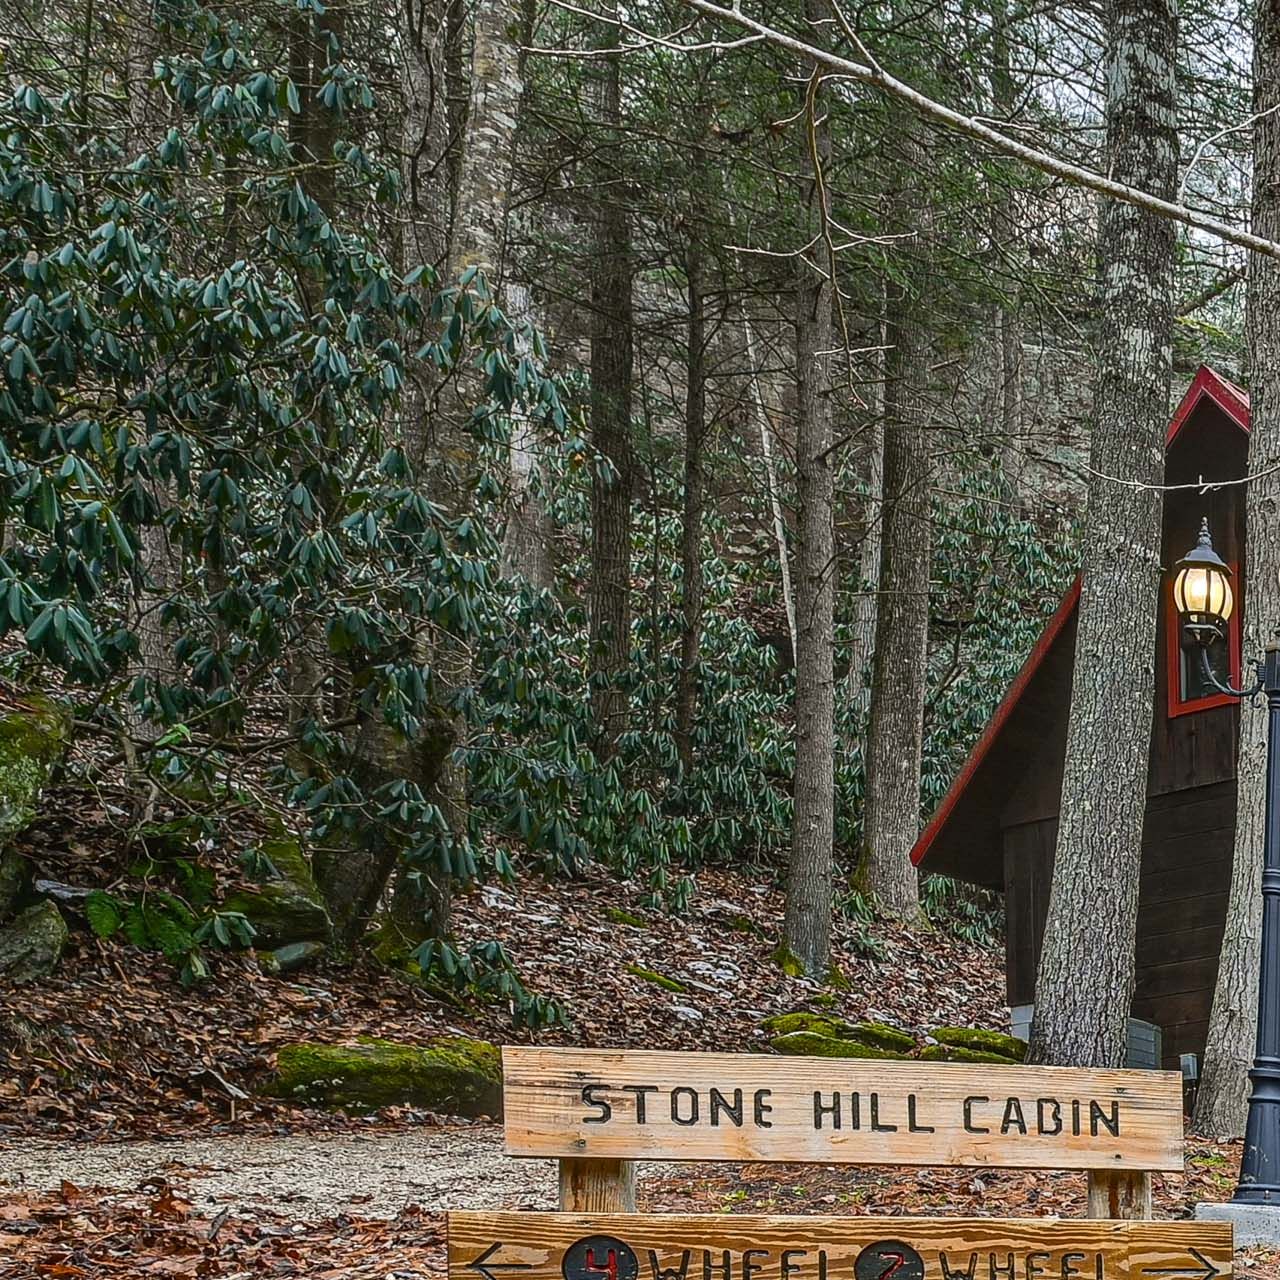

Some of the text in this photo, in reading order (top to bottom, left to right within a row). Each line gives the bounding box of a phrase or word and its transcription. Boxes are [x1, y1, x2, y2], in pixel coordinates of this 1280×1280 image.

[581, 1084, 1120, 1138] STONE HILL CABIN
